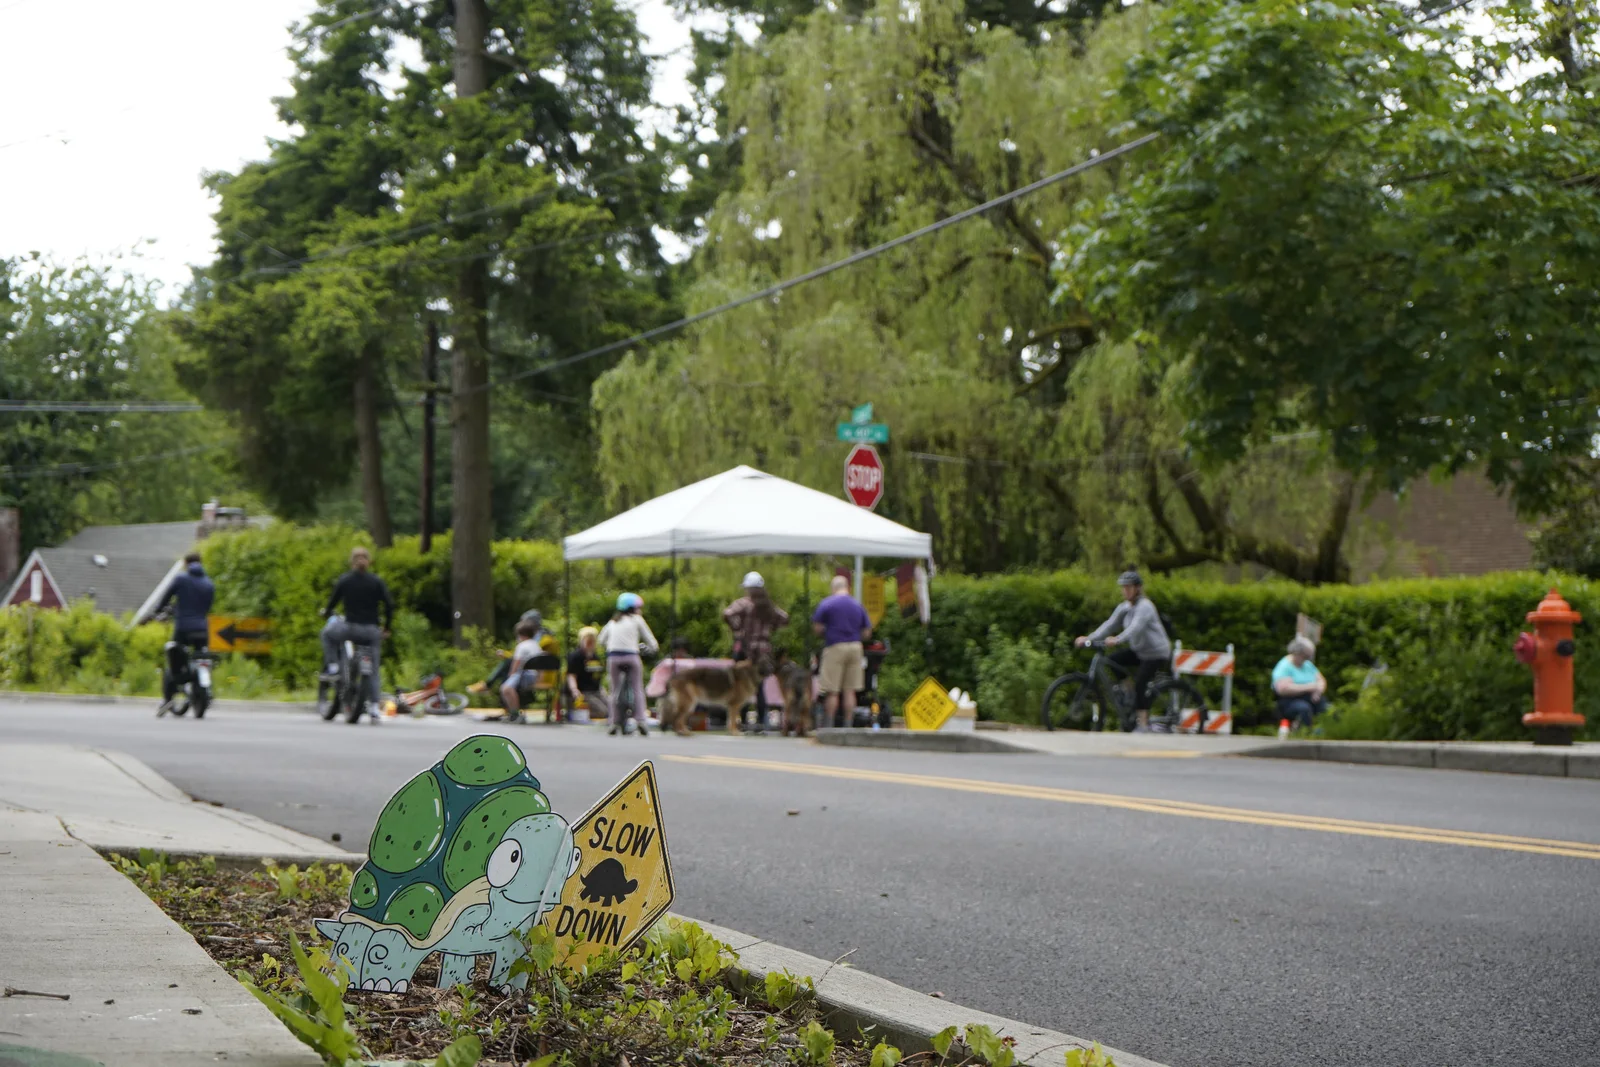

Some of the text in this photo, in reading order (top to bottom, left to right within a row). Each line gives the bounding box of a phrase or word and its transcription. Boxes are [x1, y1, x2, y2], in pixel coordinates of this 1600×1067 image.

[847, 465, 881, 492] STOP
[589, 816, 656, 858] SLOW
[555, 905, 627, 947] DOWN
